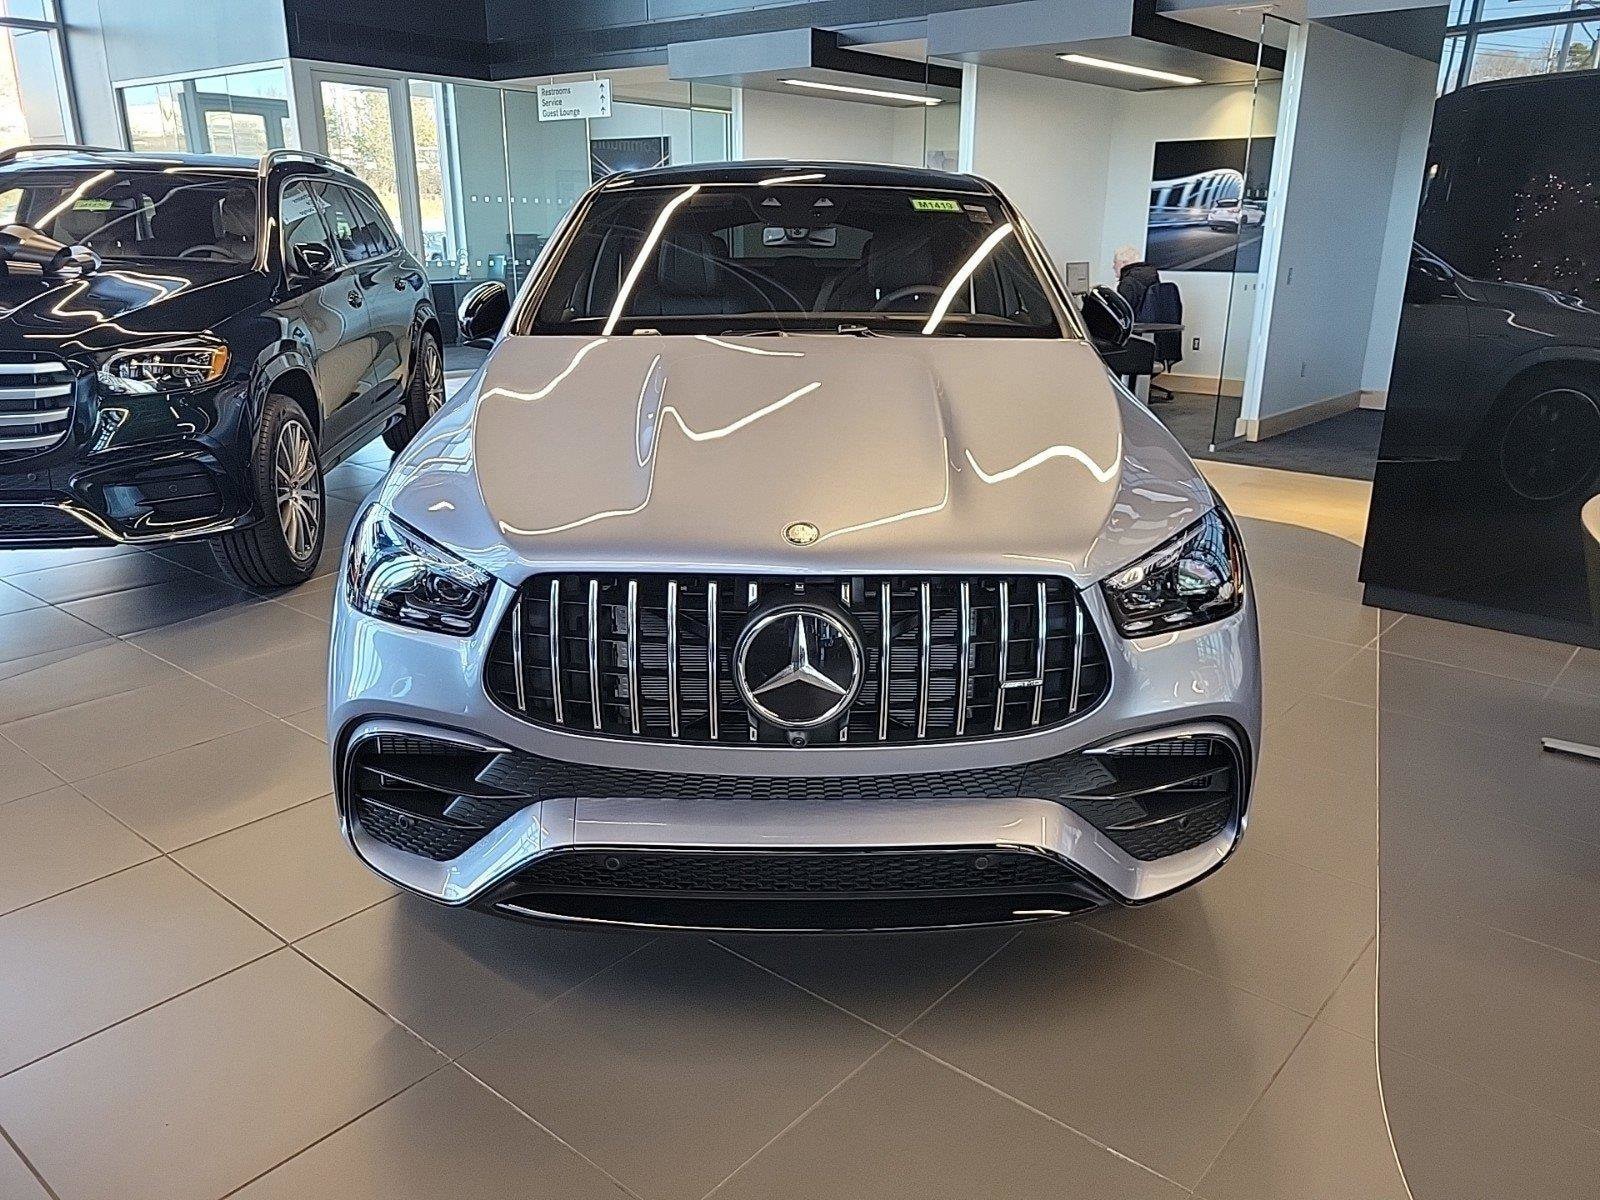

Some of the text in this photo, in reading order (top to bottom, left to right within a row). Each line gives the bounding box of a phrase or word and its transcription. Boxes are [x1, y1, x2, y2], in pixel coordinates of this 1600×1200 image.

[541, 88, 571, 96] Restrooms
[541, 99, 563, 107] Service
[542, 108, 580, 118] Guest Lounge
[917, 201, 953, 209] M1419
